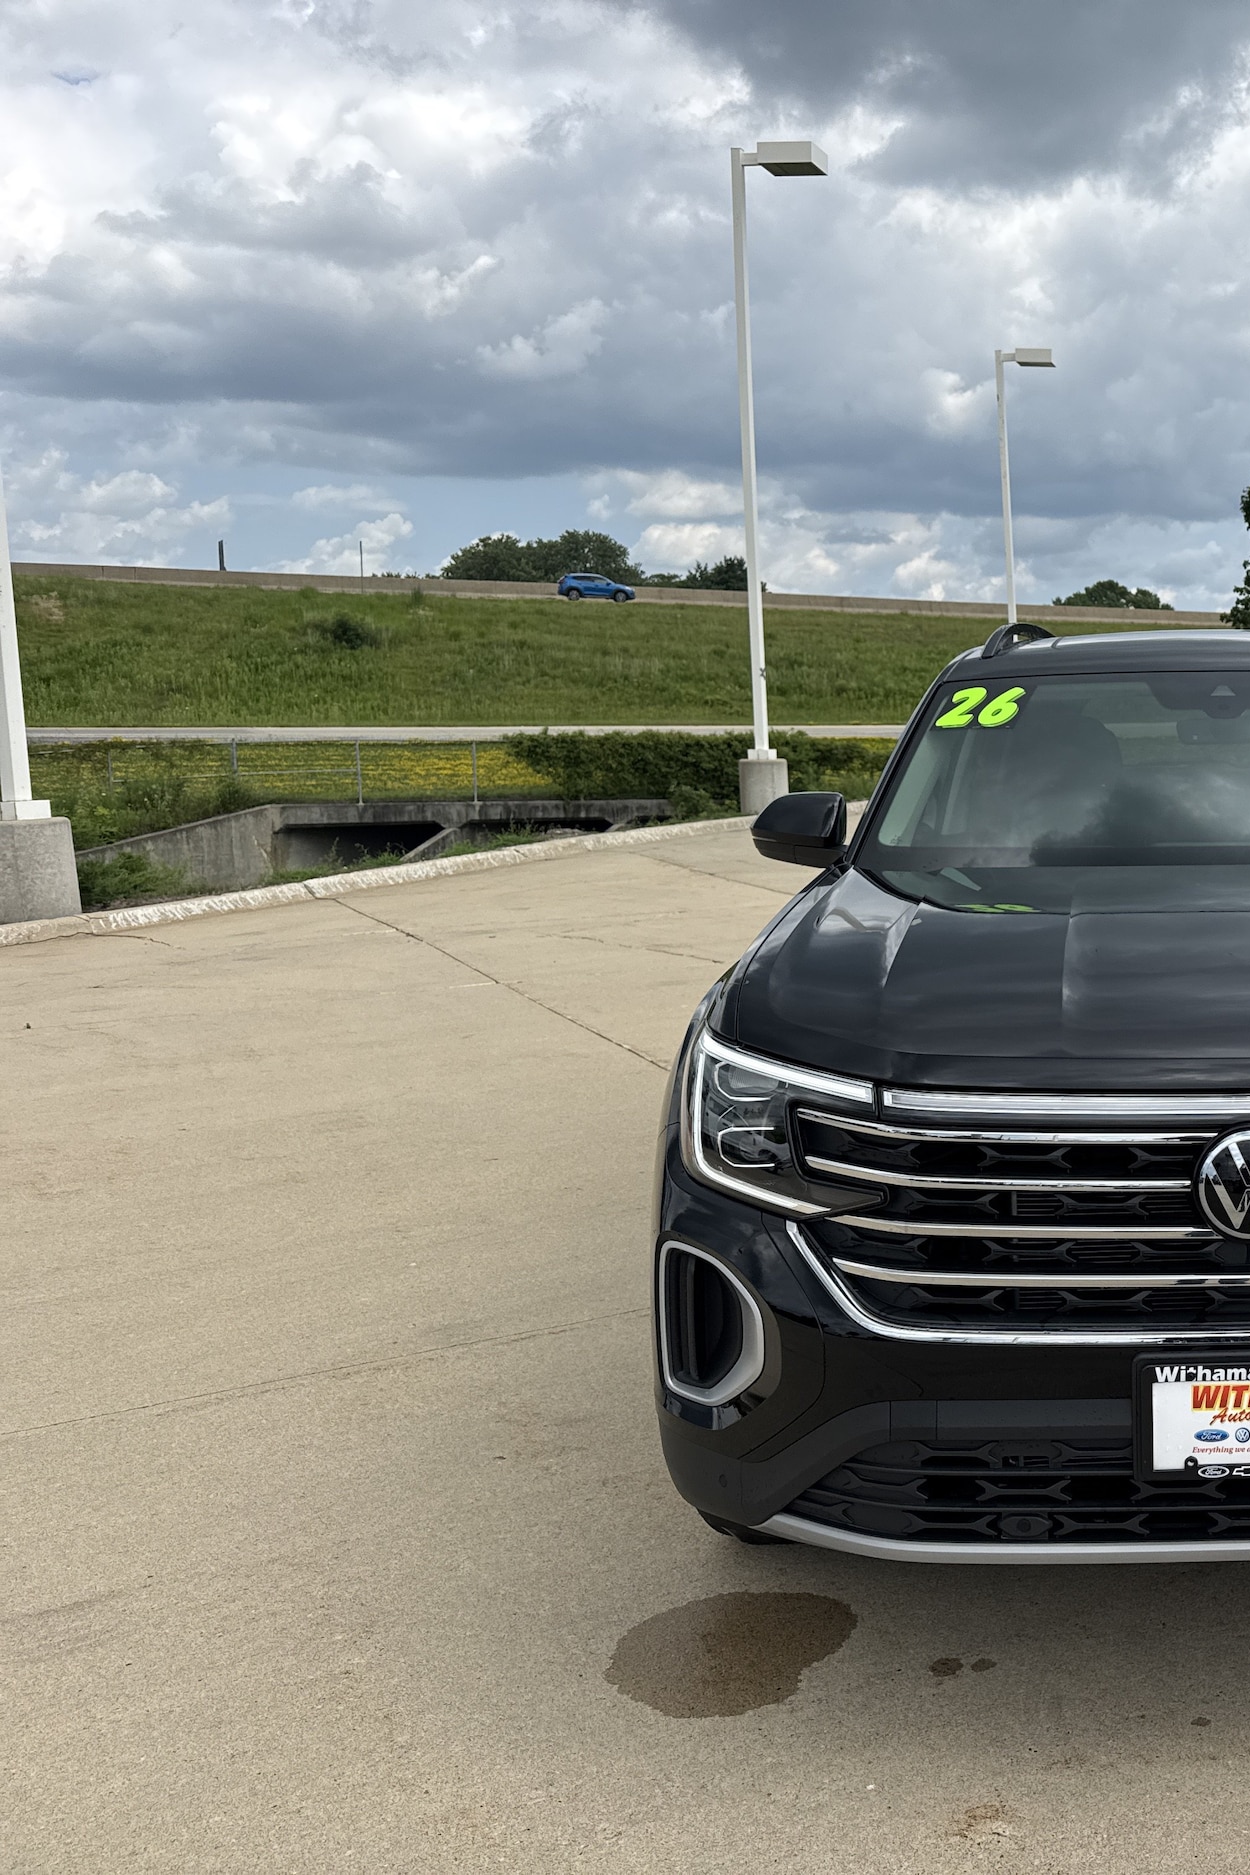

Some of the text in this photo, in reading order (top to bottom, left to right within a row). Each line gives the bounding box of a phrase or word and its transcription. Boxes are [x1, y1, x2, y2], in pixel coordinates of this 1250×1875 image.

[935, 686, 1027, 728] 26
[1200, 1430, 1223, 1441] Ford
[1192, 1446, 1234, 1455] Everything
